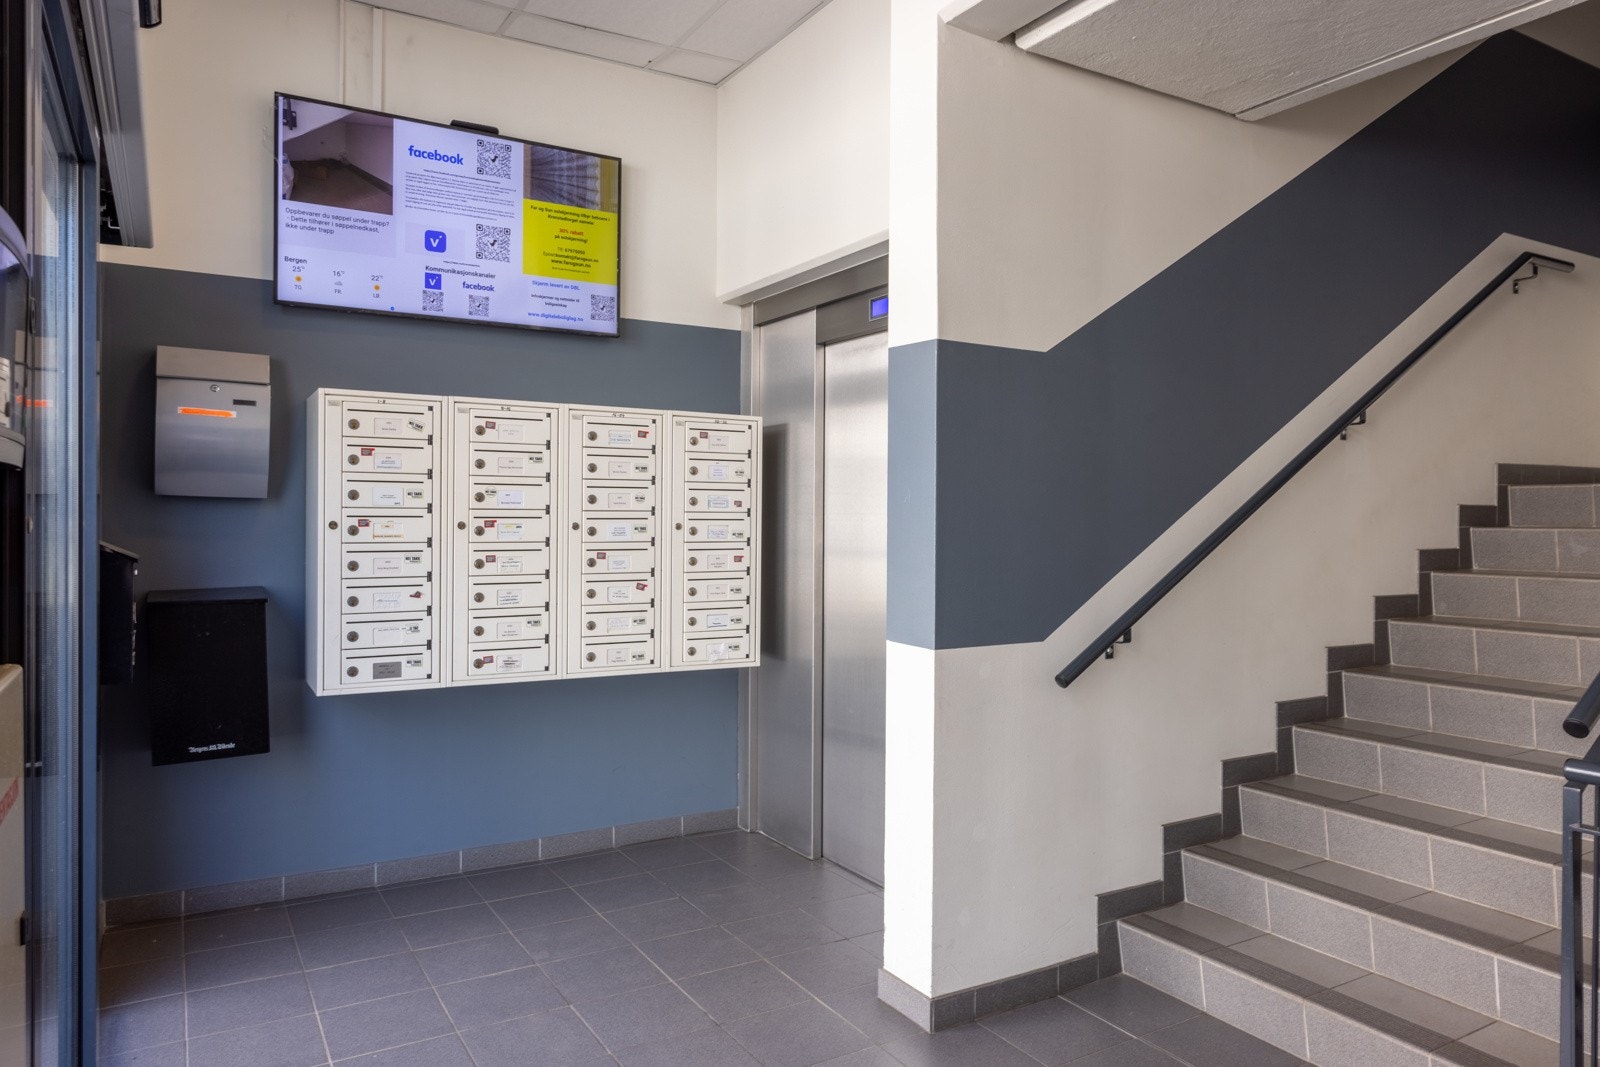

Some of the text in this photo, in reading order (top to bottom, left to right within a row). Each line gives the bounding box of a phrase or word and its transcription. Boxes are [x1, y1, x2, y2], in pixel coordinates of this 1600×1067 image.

[408, 145, 464, 165] facebook
[286, 207, 320, 217] Oppbevarer
[309, 218, 330, 226] tilhører
[335, 221, 380, 233] søppelnedkast,
[284, 256, 308, 264] Bergen
[425, 265, 496, 279] Kommunikasjonskanaler
[462, 281, 495, 292] facebook
